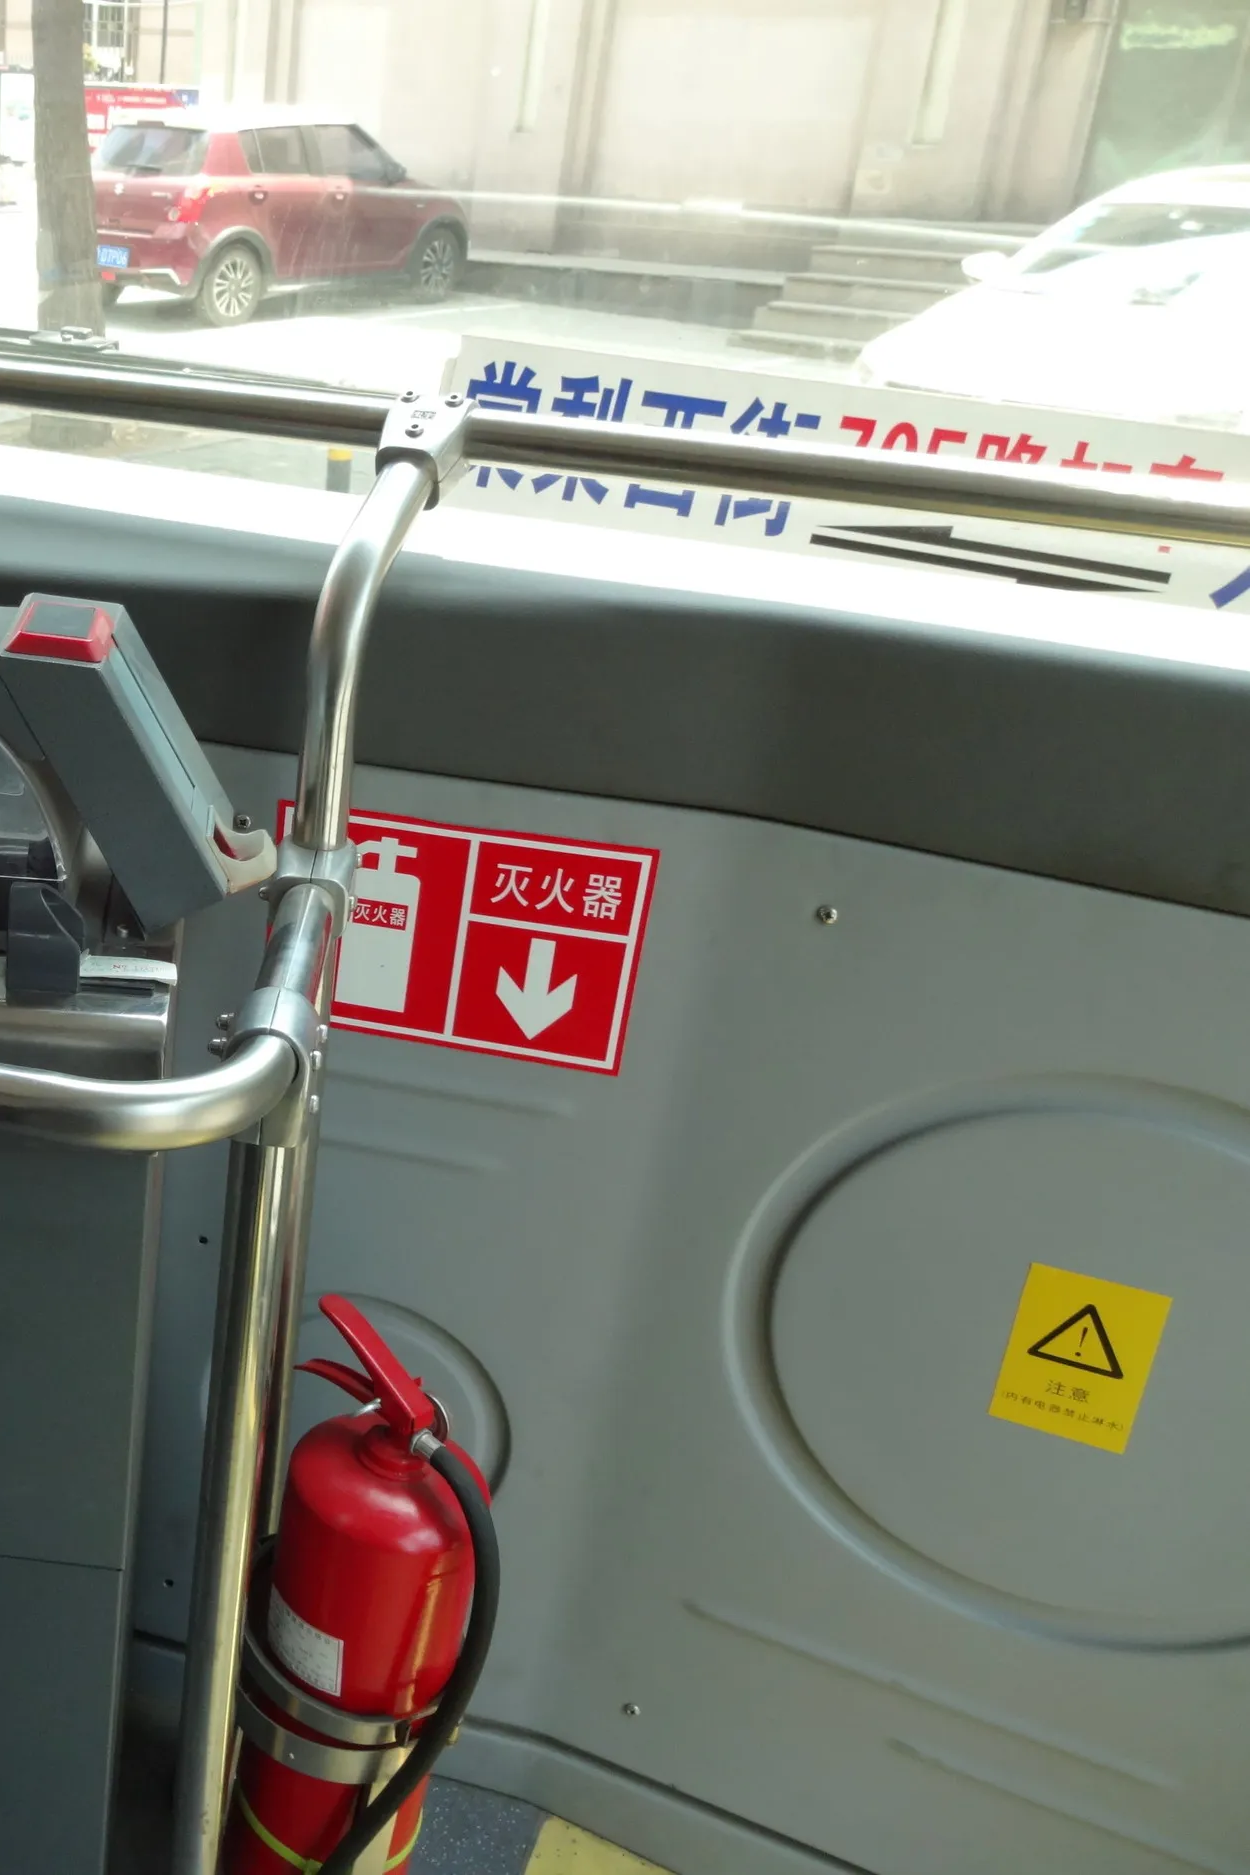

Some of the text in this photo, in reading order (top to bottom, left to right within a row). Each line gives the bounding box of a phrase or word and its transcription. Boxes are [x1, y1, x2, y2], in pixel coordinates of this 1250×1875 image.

[490, 862, 623, 921] 灭火器
[353, 901, 407, 927] 灭火器
[1045, 1379, 1091, 1404] 注意
